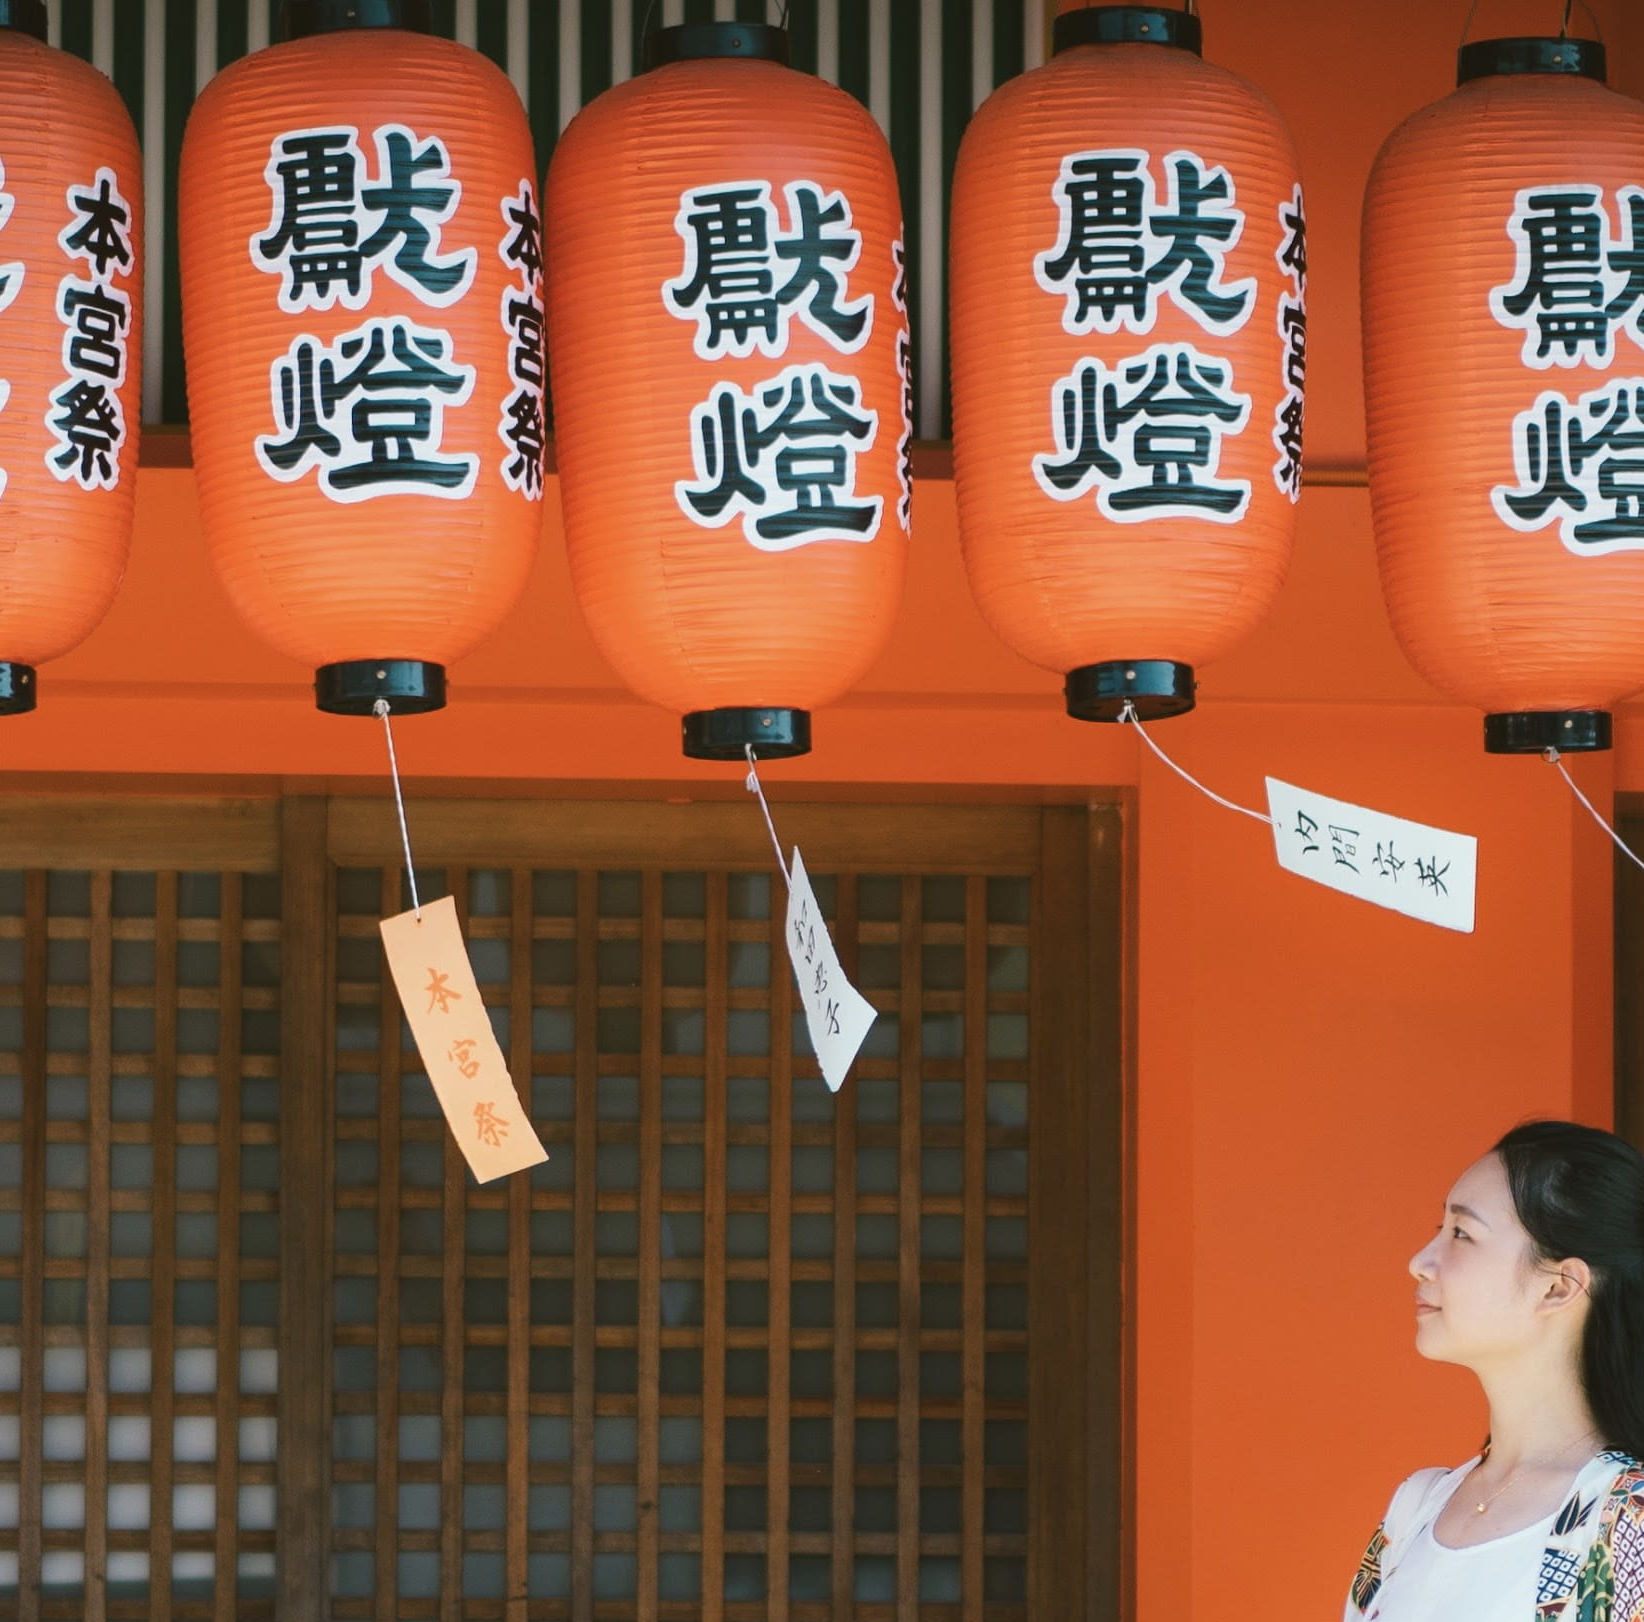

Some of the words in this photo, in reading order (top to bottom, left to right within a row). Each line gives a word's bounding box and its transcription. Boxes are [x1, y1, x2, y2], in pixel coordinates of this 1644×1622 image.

[47, 170, 129, 488] 本宮祭
[502, 183, 543, 497] 本宮祭
[1293, 808, 1453, 898] 内間安英
[423, 966, 511, 1149] 本宮祭
